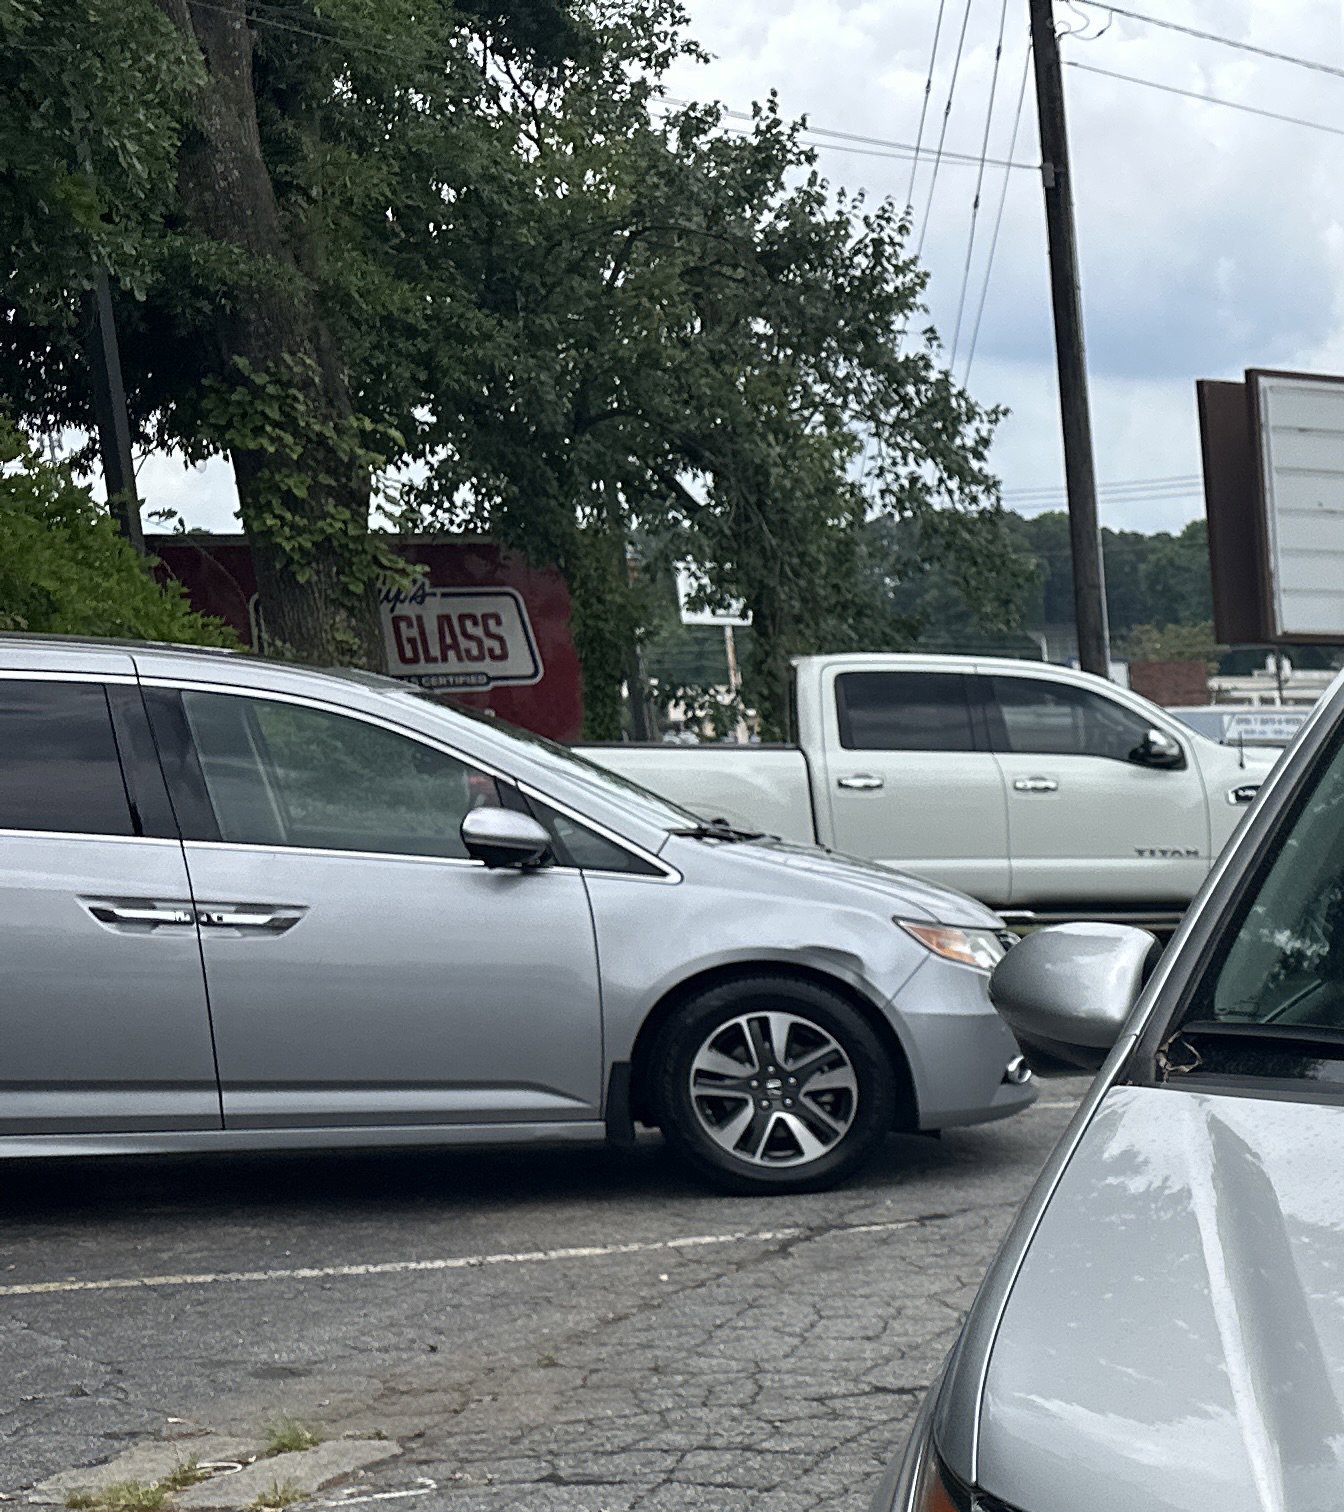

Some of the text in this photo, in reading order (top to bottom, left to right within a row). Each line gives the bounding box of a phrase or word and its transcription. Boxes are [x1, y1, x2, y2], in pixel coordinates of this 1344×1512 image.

[391, 611, 509, 665] GLASS
[422, 673, 488, 687] CERTIFIED
[1133, 847, 1200, 859] TITAN
